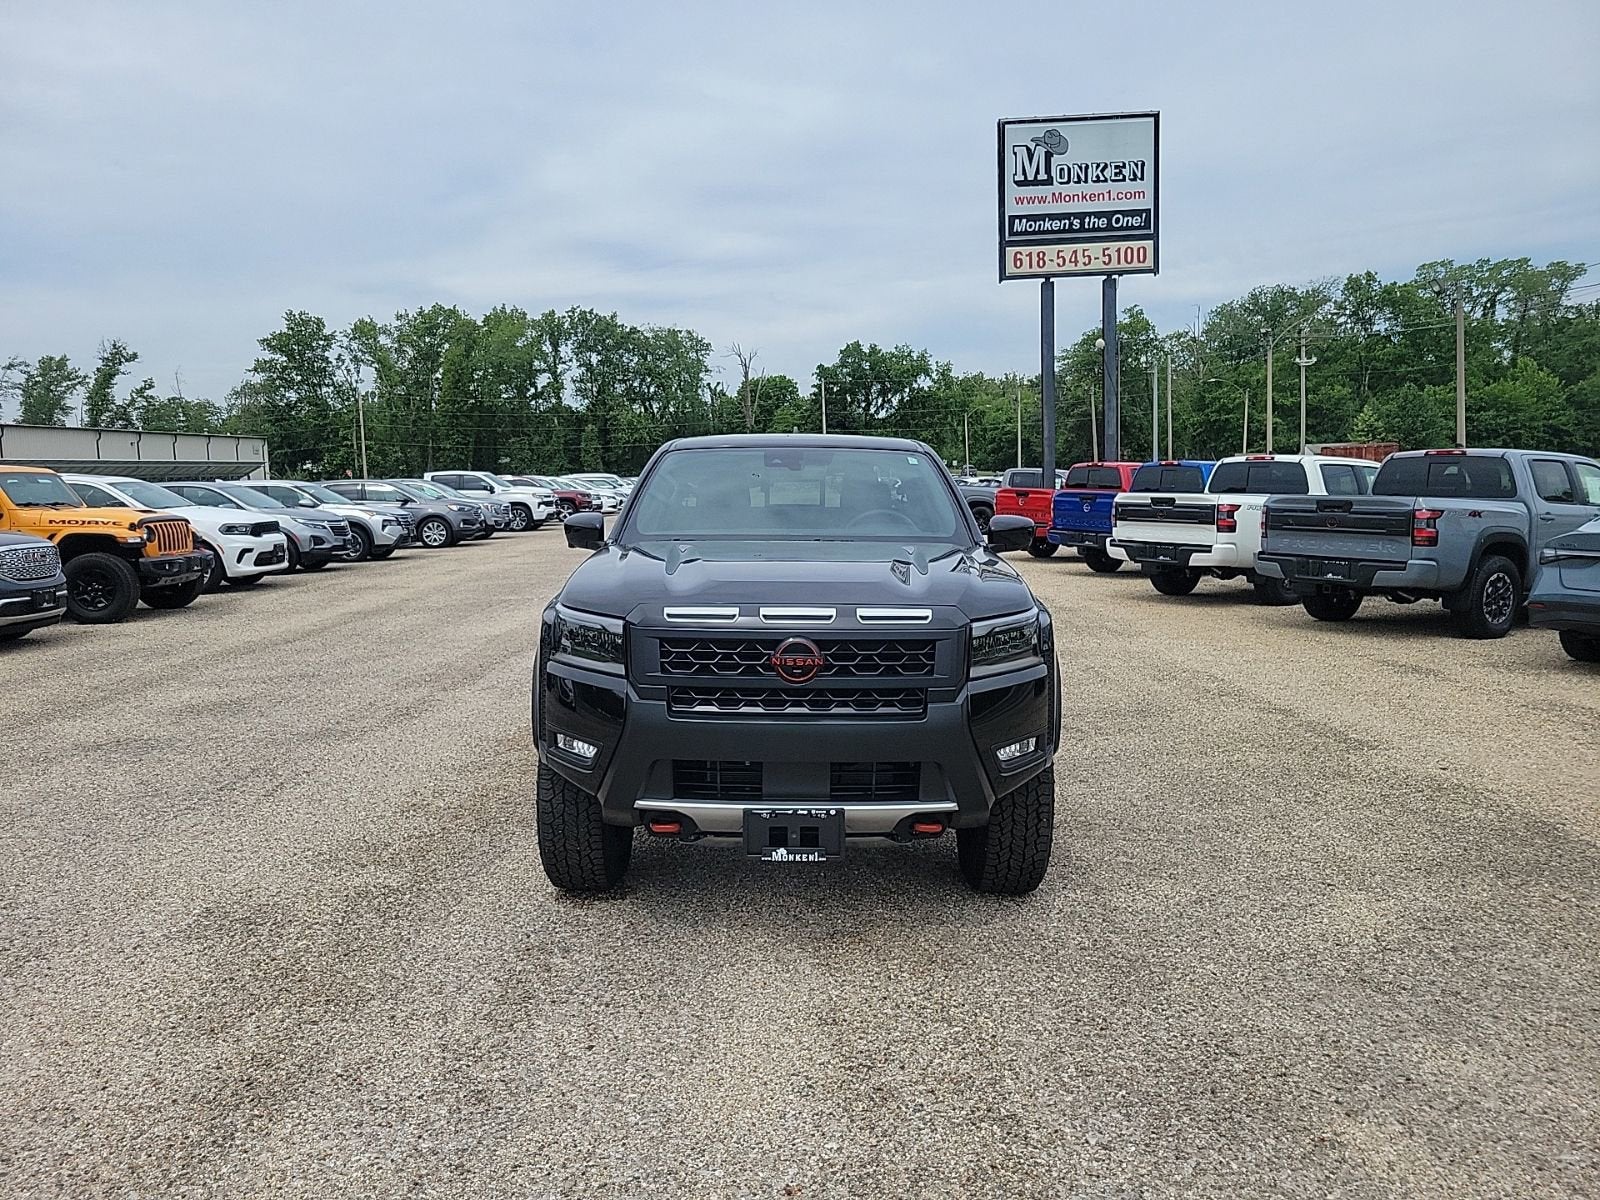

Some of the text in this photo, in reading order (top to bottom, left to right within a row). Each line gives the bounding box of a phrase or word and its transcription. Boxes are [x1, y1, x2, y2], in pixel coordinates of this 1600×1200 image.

[1012, 144, 1146, 187] MONKEN
[1014, 189, 1146, 205] www.Monken1.com
[1013, 212, 1147, 233] Monken's the One!
[1013, 245, 1148, 270] 618-545-5100
[48, 519, 123, 527] MOJAVE
[771, 657, 824, 666] NISSAN
